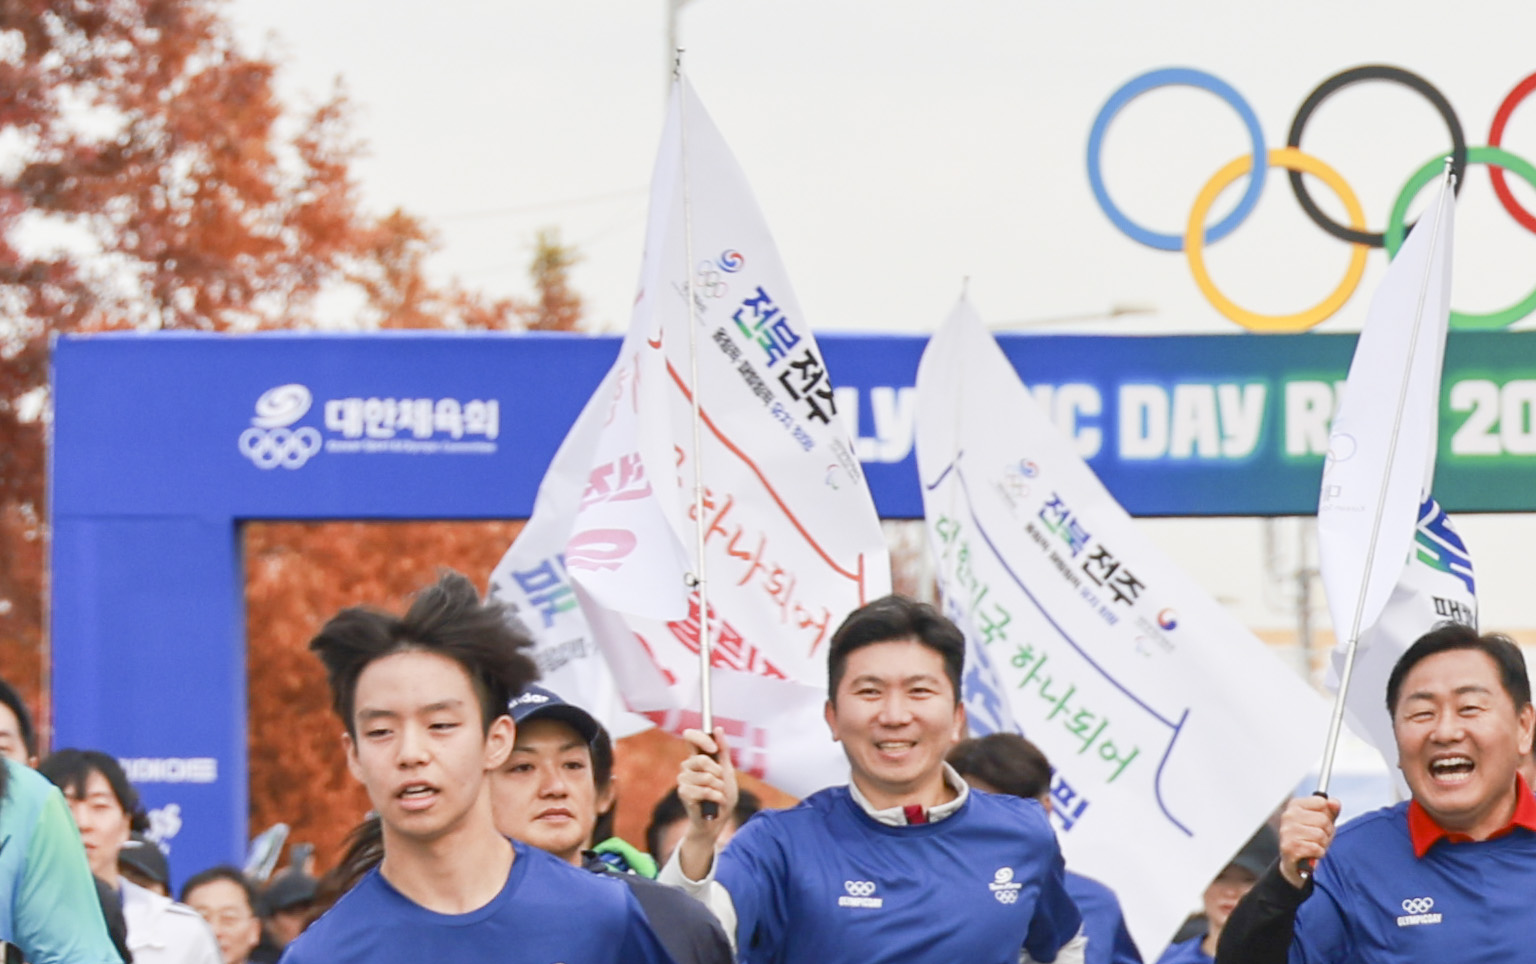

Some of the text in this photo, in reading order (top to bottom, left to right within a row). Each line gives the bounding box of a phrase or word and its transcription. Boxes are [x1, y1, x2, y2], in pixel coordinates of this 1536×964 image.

[731, 285, 803, 368] 전북
[323, 396, 500, 441] 대한체육회
[1119, 382, 1266, 459] DAY
[687, 487, 832, 659] 하나되어
[1037, 490, 1147, 607] 전북 전주
[1009, 642, 1142, 785] 하나되어
